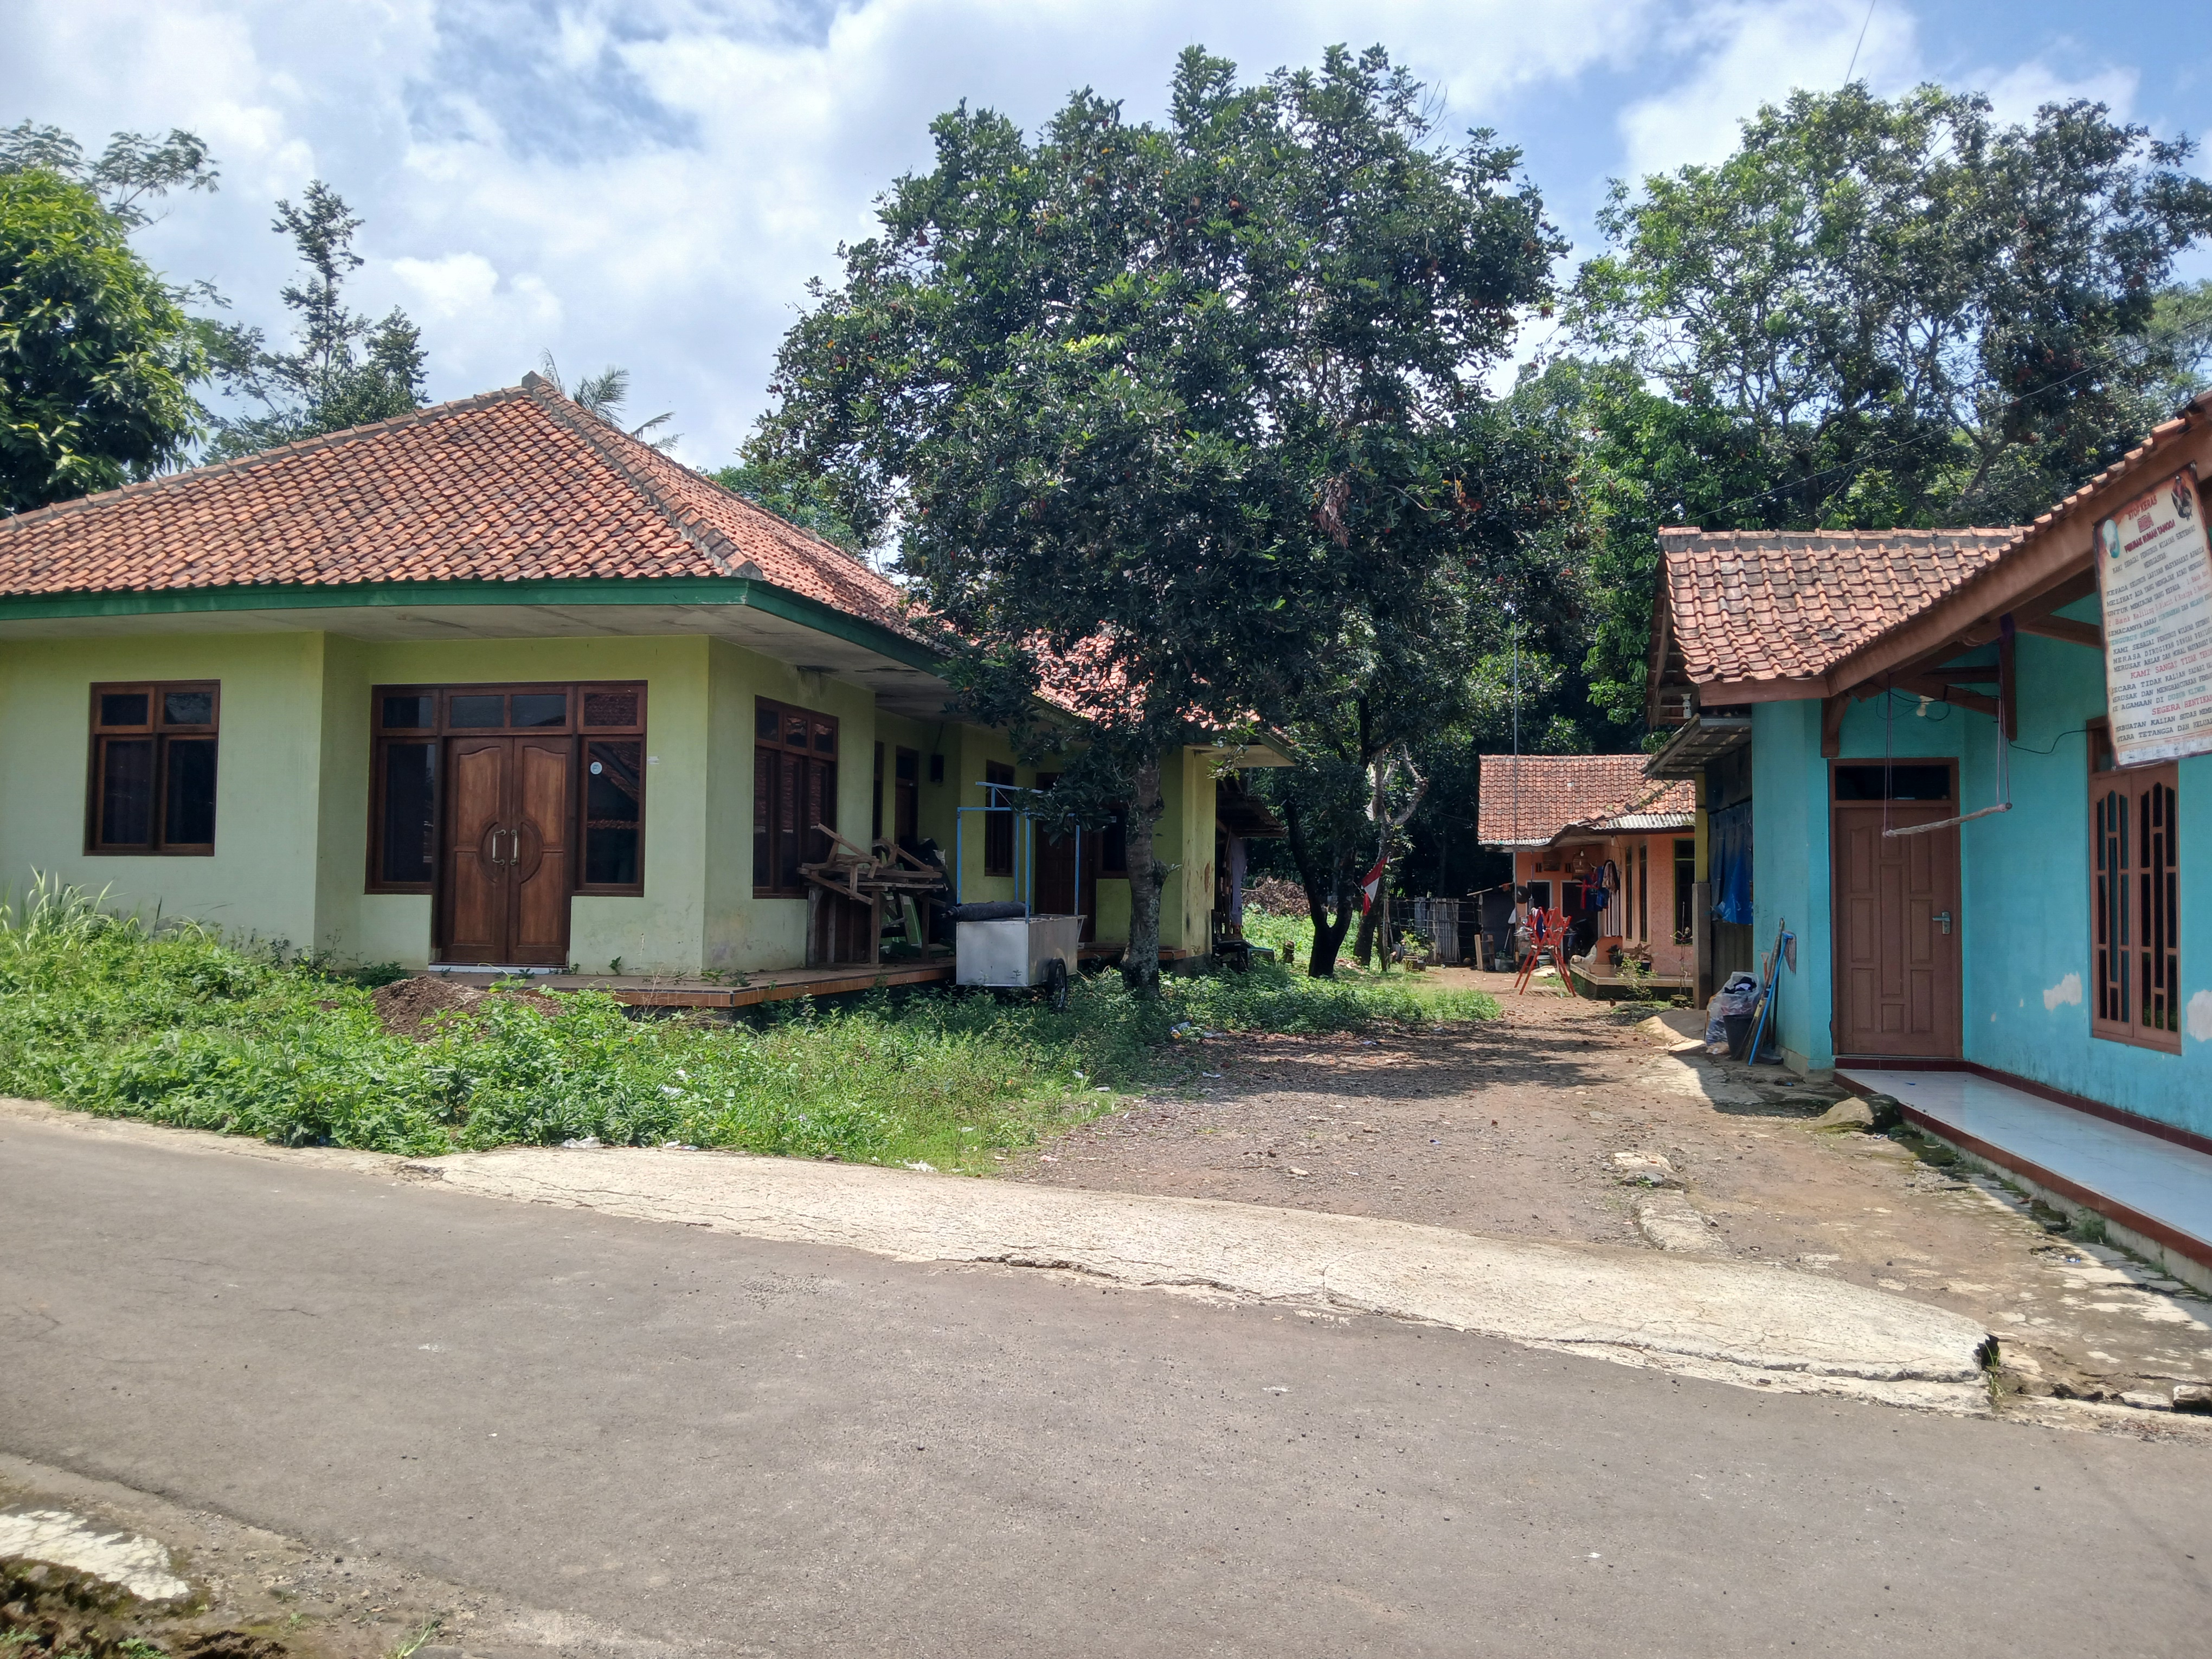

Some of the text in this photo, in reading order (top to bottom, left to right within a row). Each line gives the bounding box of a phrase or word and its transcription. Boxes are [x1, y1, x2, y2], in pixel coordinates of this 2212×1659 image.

[2129, 495, 2157, 520] STOP KERAS
[2142, 529, 2158, 543] RUMAH
[2157, 519, 2176, 535] TANGGA
[2112, 564, 2123, 574] KAMI
[2159, 536, 2175, 549] WILAYAH
[2176, 525, 2195, 539] SETEMPAT
[2107, 585, 2128, 596] KEPADA
[2147, 567, 2164, 579] LAPISAN
[2164, 554, 2189, 571] MASYARAKAT
[2190, 546, 2204, 558] APABILA
[2107, 594, 2132, 607] MELIHAT
[2144, 583, 2155, 593] YANG
[2155, 574, 2174, 587] MENGAJAK
[2176, 568, 2187, 577] ATAU
[2107, 607, 2128, 616] UNTUK
[2130, 596, 2152, 610] MEMINJAM
[2153, 591, 2164, 600] UANG
[2165, 583, 2181, 595] KEPADA
[2133, 608, 2155, 620] Keliling
[2144, 617, 2157, 627] HARAP
[2113, 646, 2128, 654] KAMI
[2132, 639, 2155, 650] SEBAGAI
[2157, 631, 2176, 642] PENGURUS
[2178, 623, 2194, 634] WILAYAH
[2113, 653, 2141, 664] MERASA
[2145, 642, 2175, 657] DIRUGIKAN
[2176, 635, 2192, 646] DENGAN
[2114, 661, 2141, 672] MERUSAK
[2144, 656, 2160, 666] AHLAK
[2172, 647, 2187, 657] MORAL
[2187, 639, 2208, 652] MASYARAKAT
[2130, 668, 2150, 679] KAMI
[2155, 661, 2177, 673] SANGAT
[2181, 654, 2197, 665] TIDAK
[2140, 678, 2162, 687] TIDAK
[2165, 671, 2185, 681] KALIAN
[2188, 665, 2205, 674] SADARI
[2157, 678, 2196, 693] MENGHANCURKAN
[2121, 699, 2152, 710] AGAMAAN
[2168, 691, 2185, 701] DUSUN
[2152, 703, 2181, 715] SEGERA
[2138, 727, 2174, 737] TETANGGA
[2177, 723, 2189, 731] DAN
[2150, 716, 2175, 725] KALIAN
[2179, 711, 2197, 720] SUDAH
